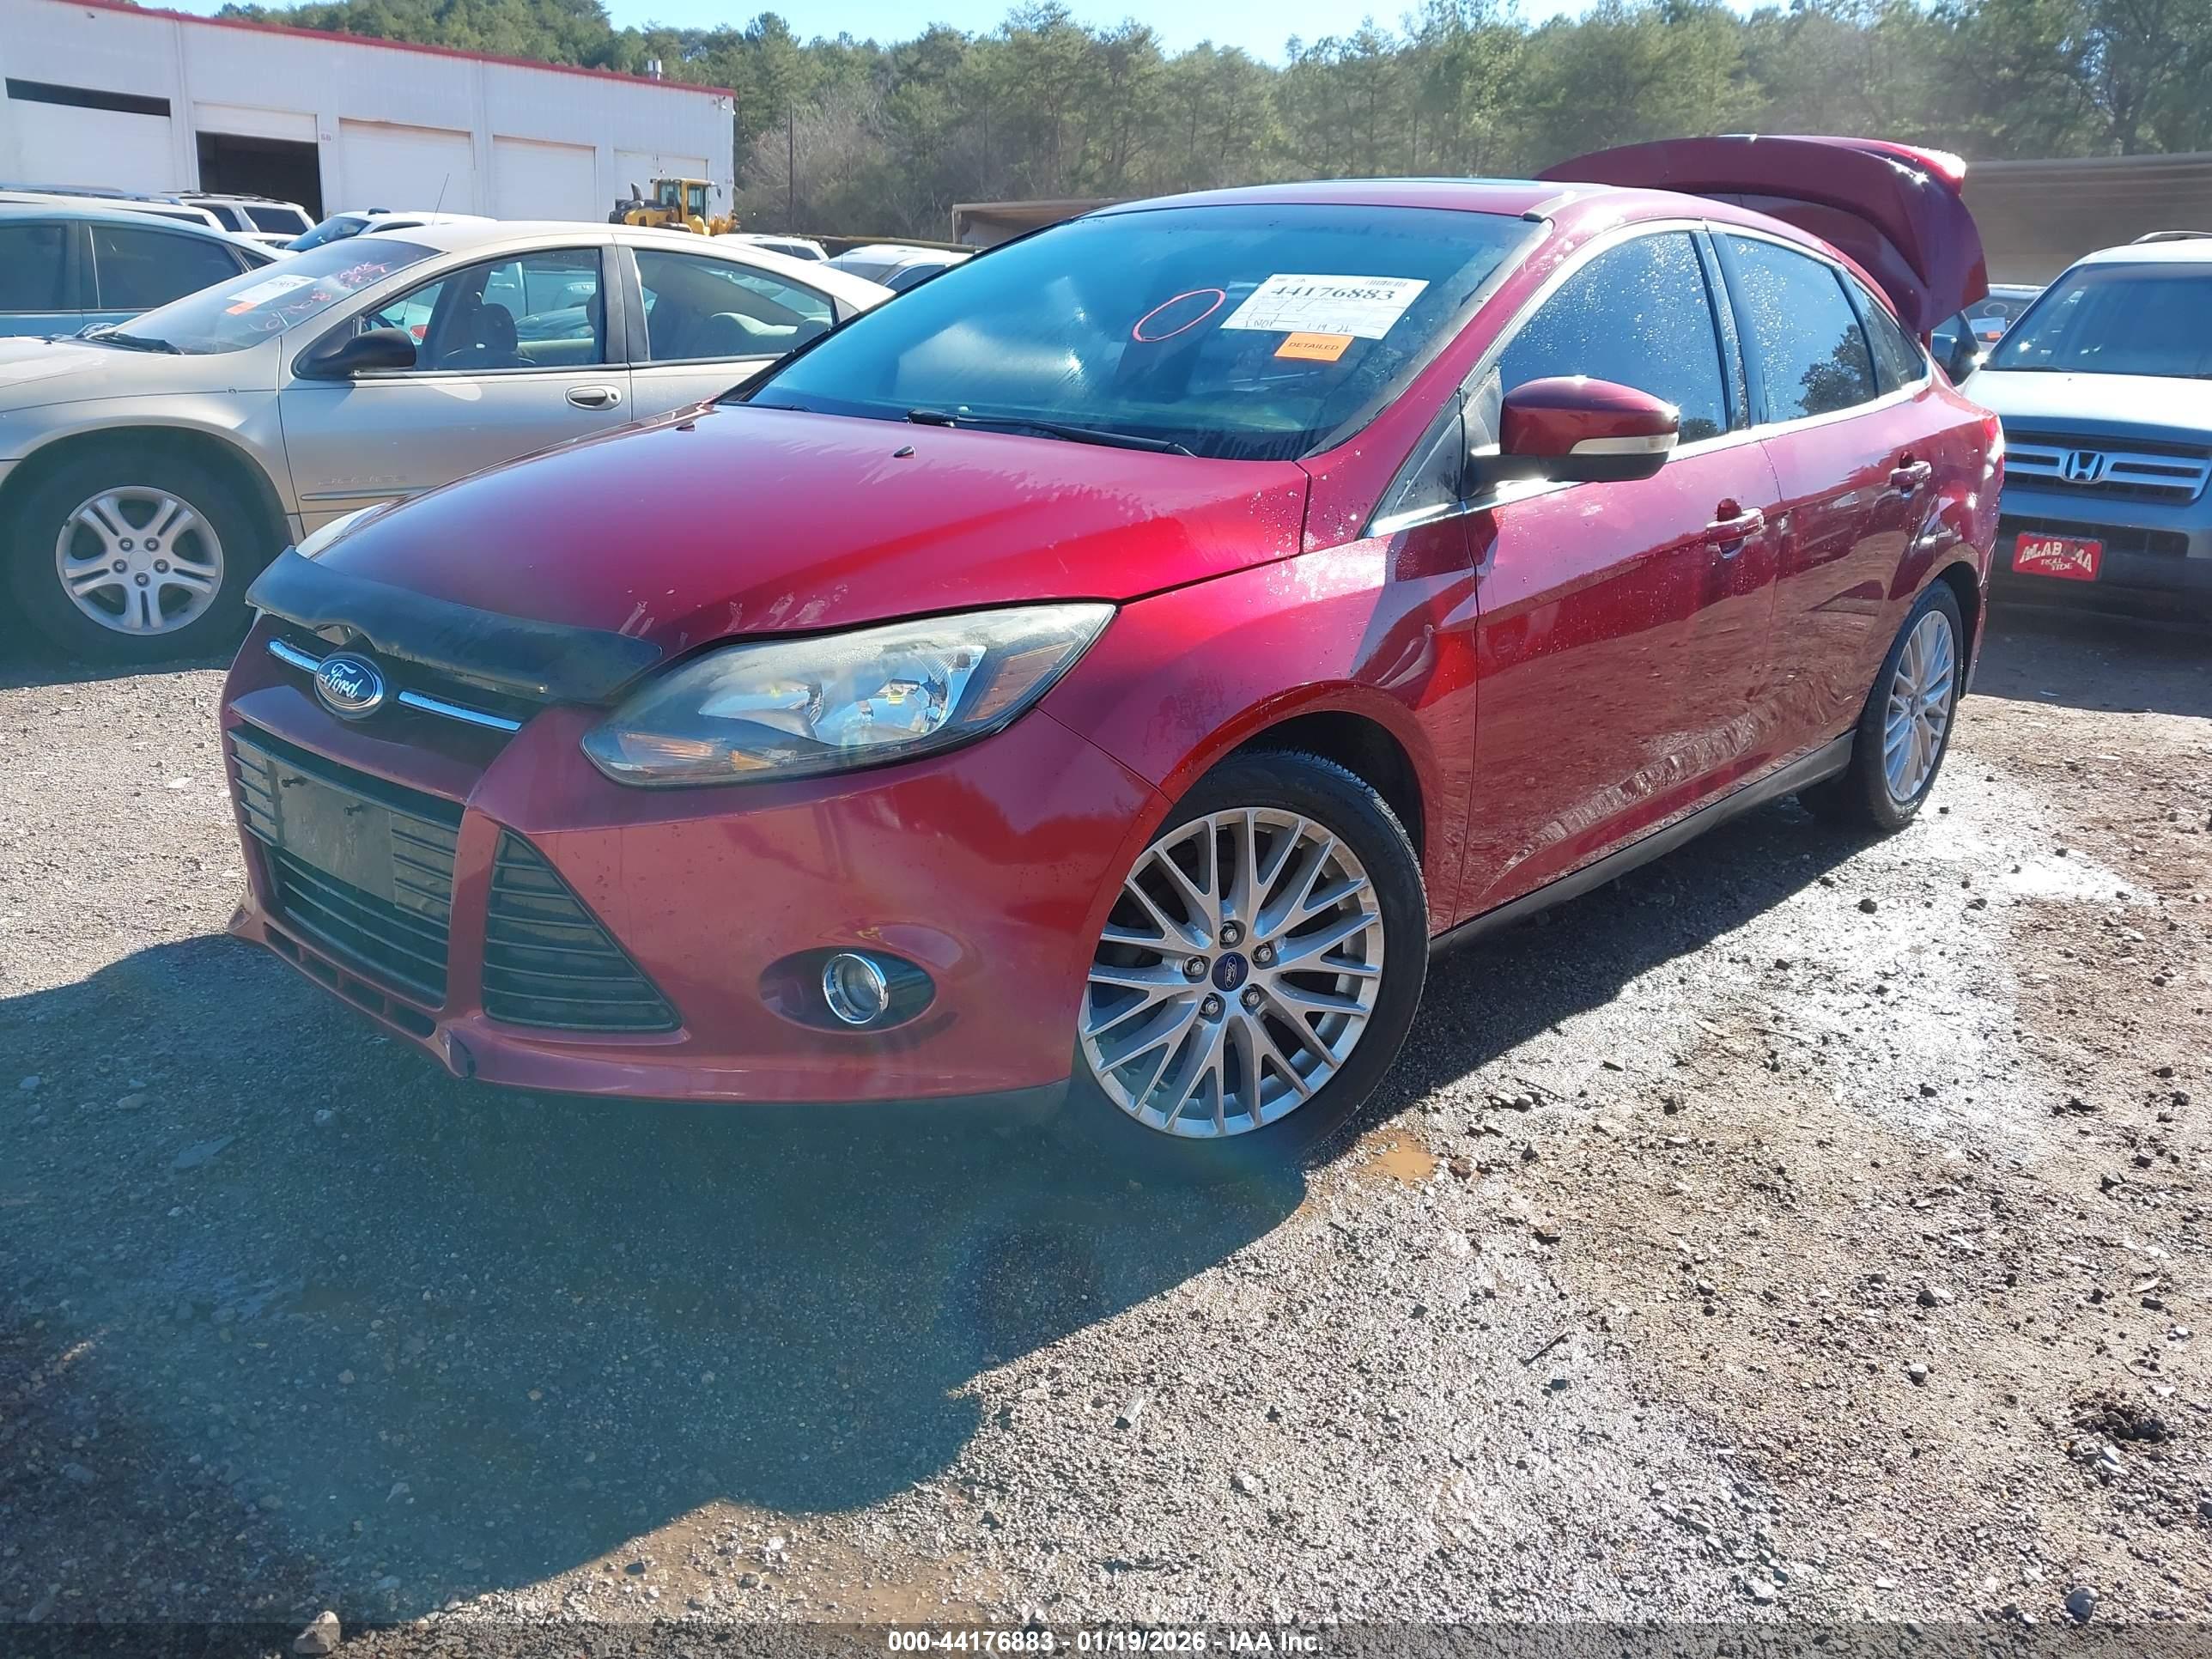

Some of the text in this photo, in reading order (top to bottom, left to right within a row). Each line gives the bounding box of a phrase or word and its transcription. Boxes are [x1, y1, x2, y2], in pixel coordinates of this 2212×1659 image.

[1270, 285, 1395, 301] 44176883
[1288, 342, 1339, 351] DETAILED
[2019, 541, 2093, 573] ALABMA
[319, 663, 364, 699] Ford
